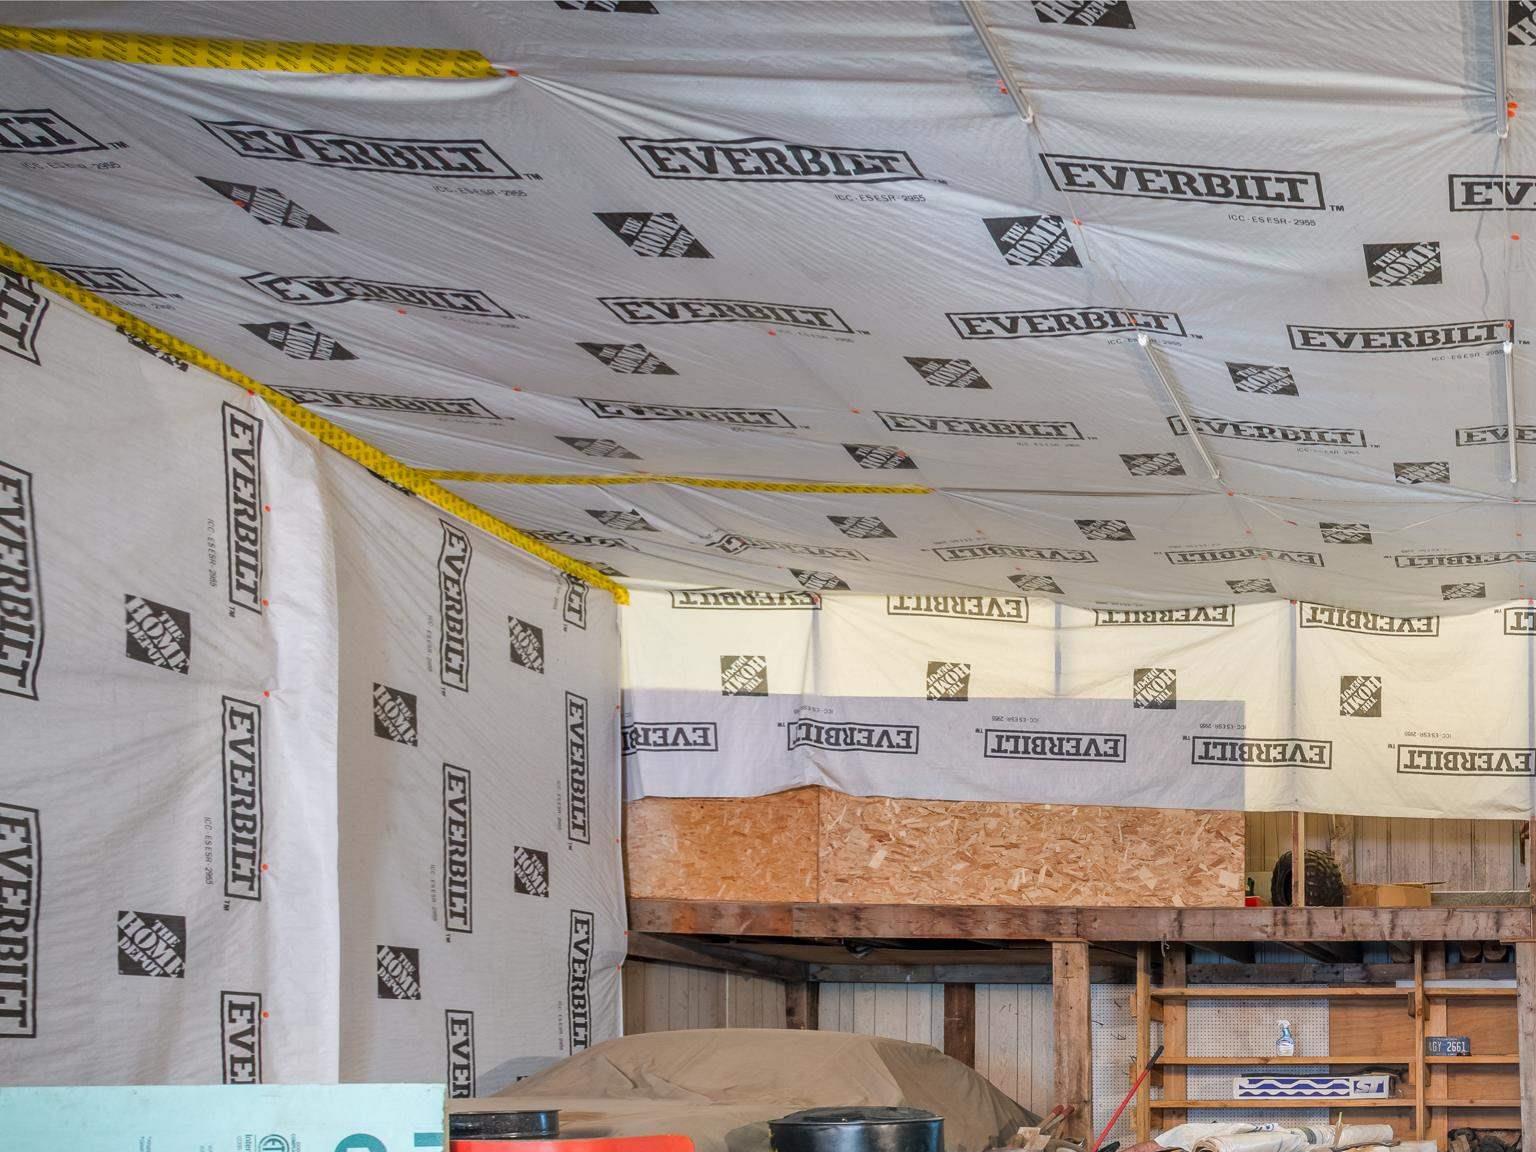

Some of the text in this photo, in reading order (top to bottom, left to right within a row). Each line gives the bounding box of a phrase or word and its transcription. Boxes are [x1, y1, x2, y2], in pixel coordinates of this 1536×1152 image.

[227, 129, 494, 173] EVERBILT
[645, 144, 902, 177] EVERBILT
[1056, 161, 1308, 203] EVERBILT
[630, 213, 681, 256] HOME
[1000, 222, 1027, 244] THE
[1004, 216, 1065, 265] HOME
[1035, 235, 1072, 266] DEPOT
[1370, 242, 1439, 285] HOME
[1373, 248, 1404, 267] THE
[1400, 258, 1440, 285] DEPOT
[265, 280, 493, 312] EVERBILT
[613, 301, 830, 327] EVERBILT
[958, 312, 1170, 335] EVERBILT
[1299, 324, 1504, 349] EVERBILT
[1235, 366, 1291, 393] HOME
[888, 415, 1068, 437] EVERBILT
[229, 414, 259, 604] EVERBILT
[443, 528, 469, 687] EVERBILT
[126, 597, 189, 671] HOME
[155, 609, 183, 642] THE
[127, 621, 166, 664] DEPOT
[722, 656, 767, 696] HOME
[927, 664, 970, 700] HOME
[928, 663, 953, 686] DEPOT
[947, 682, 966, 697] THE
[1134, 669, 1176, 708] HOME
[1135, 669, 1159, 694] DEPOT
[1341, 677, 1364, 702] DEPOT
[1154, 688, 1173, 705] THE
[1340, 677, 1381, 716] HOME
[1360, 695, 1378, 713] THE
[374, 686, 417, 745] HOME
[794, 722, 913, 750] EVERBIL
[991, 735, 1120, 757] EVERBILT
[1199, 741, 1326, 764] EVERBILT
[1404, 749, 1532, 772] EVERBILT
[568, 699, 587, 842] EVERBILT
[230, 707, 258, 892] EVERBILT
[448, 770, 469, 928] EVERBILT
[530, 854, 545, 875] THE
[514, 847, 548, 896] HOME
[515, 865, 537, 894] DEPOT
[120, 912, 184, 977] HOME
[151, 919, 179, 948] THE
[120, 937, 162, 975] DEPOT
[398, 951, 416, 975] THE
[378, 946, 420, 1000] HOME
[378, 967, 406, 998] DEPOT
[1447, 1041, 1465, 1053] 2661
